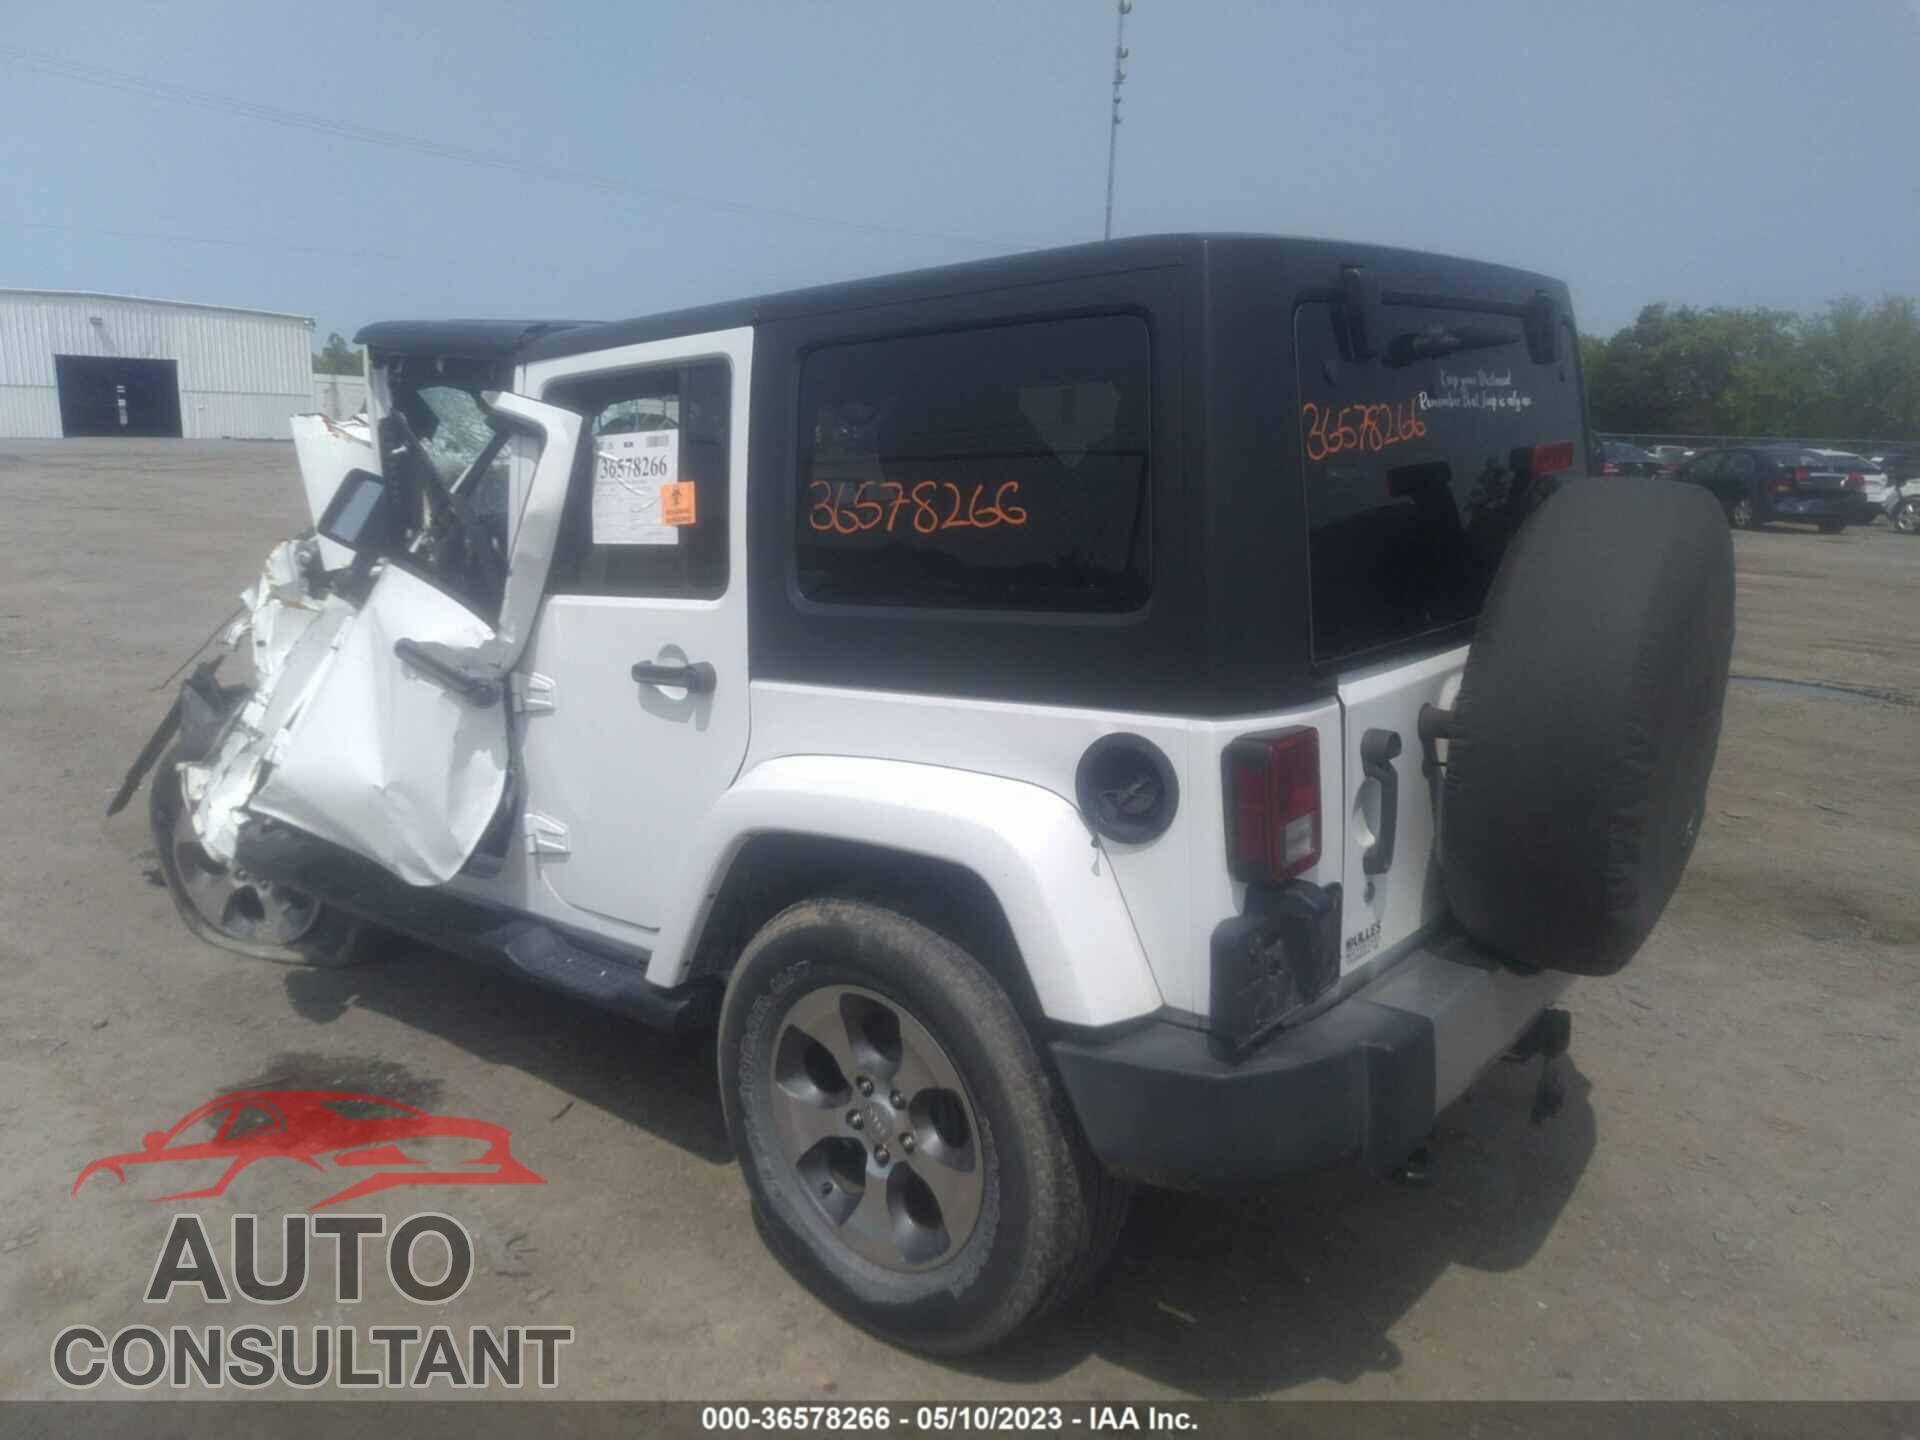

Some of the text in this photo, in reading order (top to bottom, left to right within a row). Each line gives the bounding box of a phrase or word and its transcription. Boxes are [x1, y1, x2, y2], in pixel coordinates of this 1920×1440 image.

[1303, 400, 1427, 461] 36578266
[600, 455, 668, 480] 36578266
[809, 479, 1028, 534] 36578266
